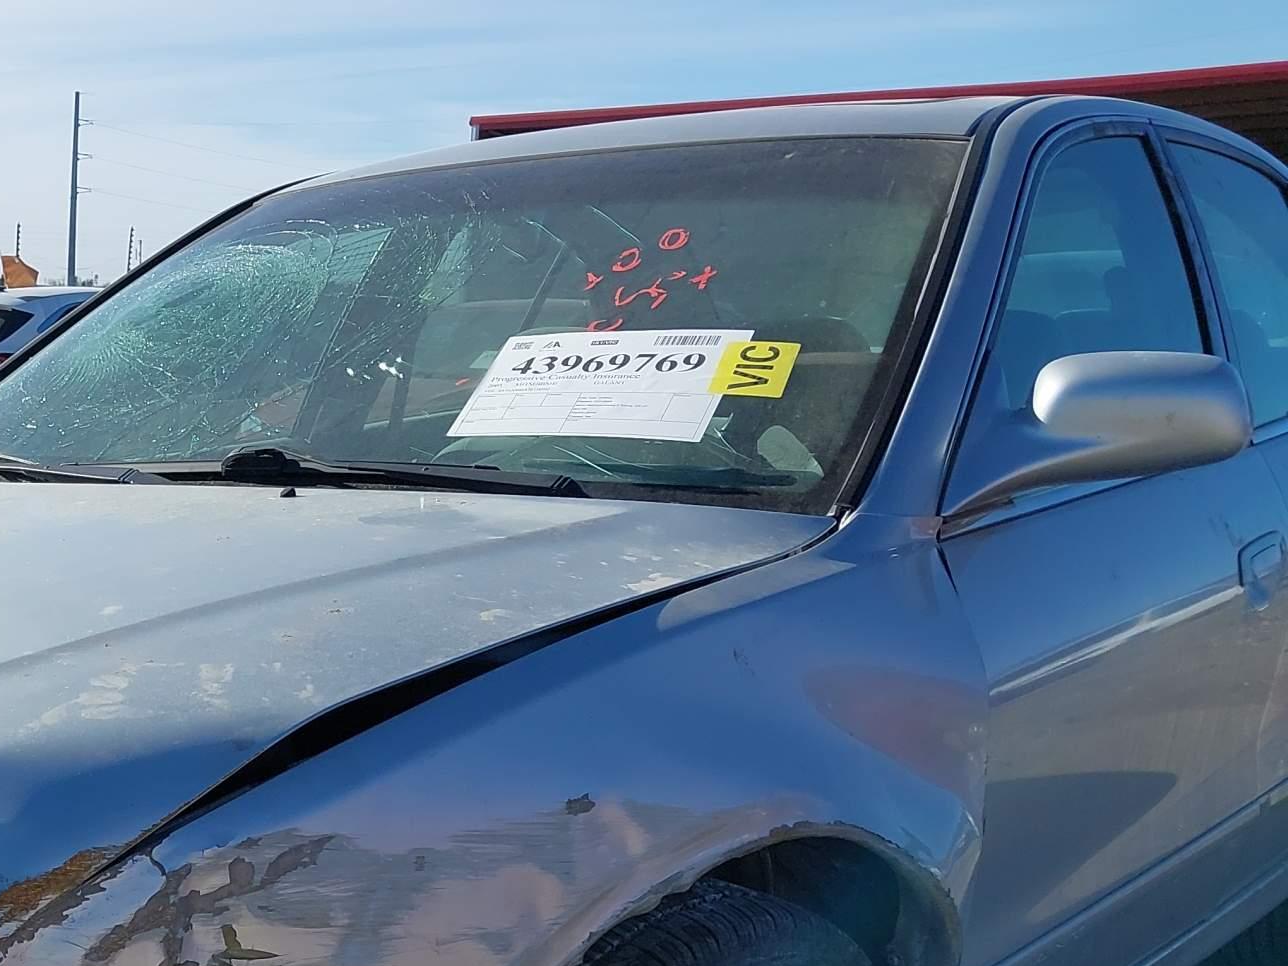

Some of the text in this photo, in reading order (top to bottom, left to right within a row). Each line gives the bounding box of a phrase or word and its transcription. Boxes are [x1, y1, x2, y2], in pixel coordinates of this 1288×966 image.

[511, 352, 707, 375] 43969769
[726, 345, 780, 391] VIC
[548, 373, 591, 381] Casualty
